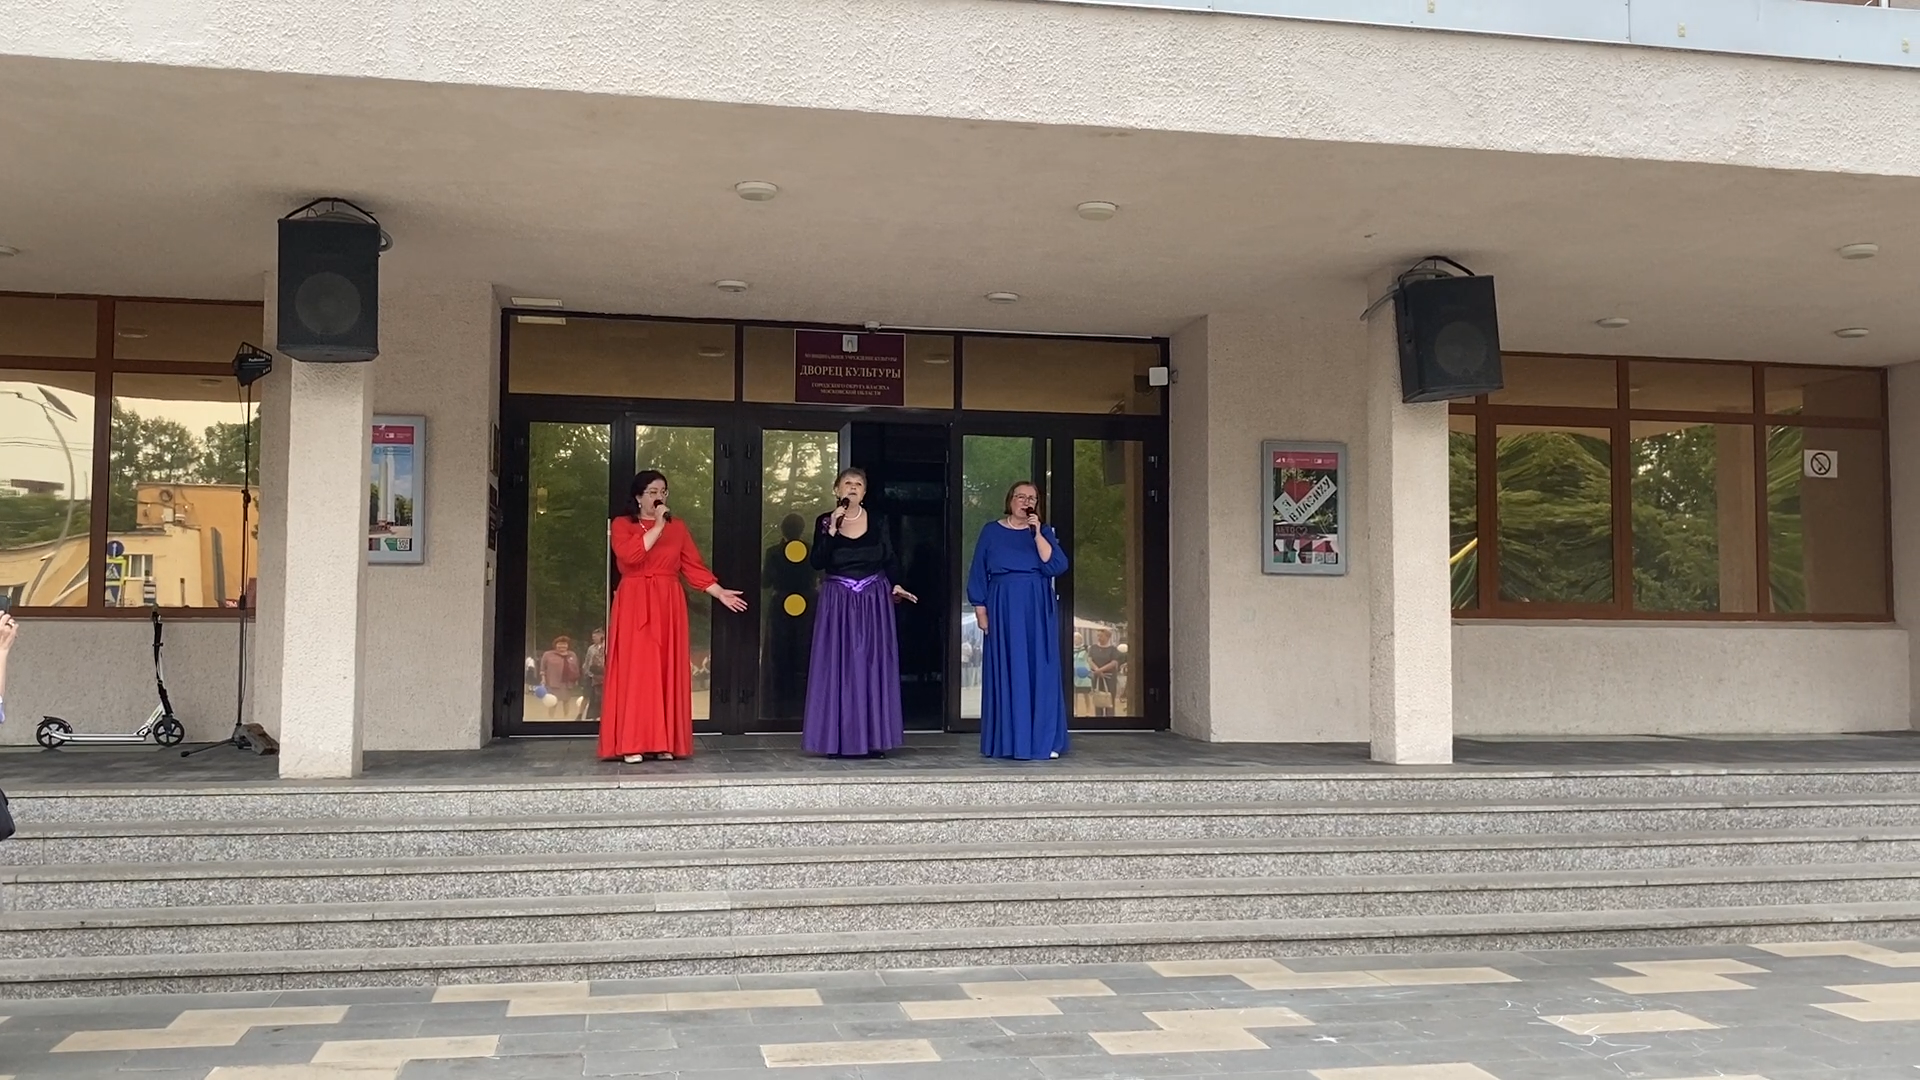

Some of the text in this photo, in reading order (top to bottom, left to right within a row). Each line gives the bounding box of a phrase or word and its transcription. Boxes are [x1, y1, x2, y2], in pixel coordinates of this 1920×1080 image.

[800, 365, 901, 379] ДВОРЕЦ КУЛЬТУРЫ
[1288, 478, 1331, 523] ВЛАСИХУ
